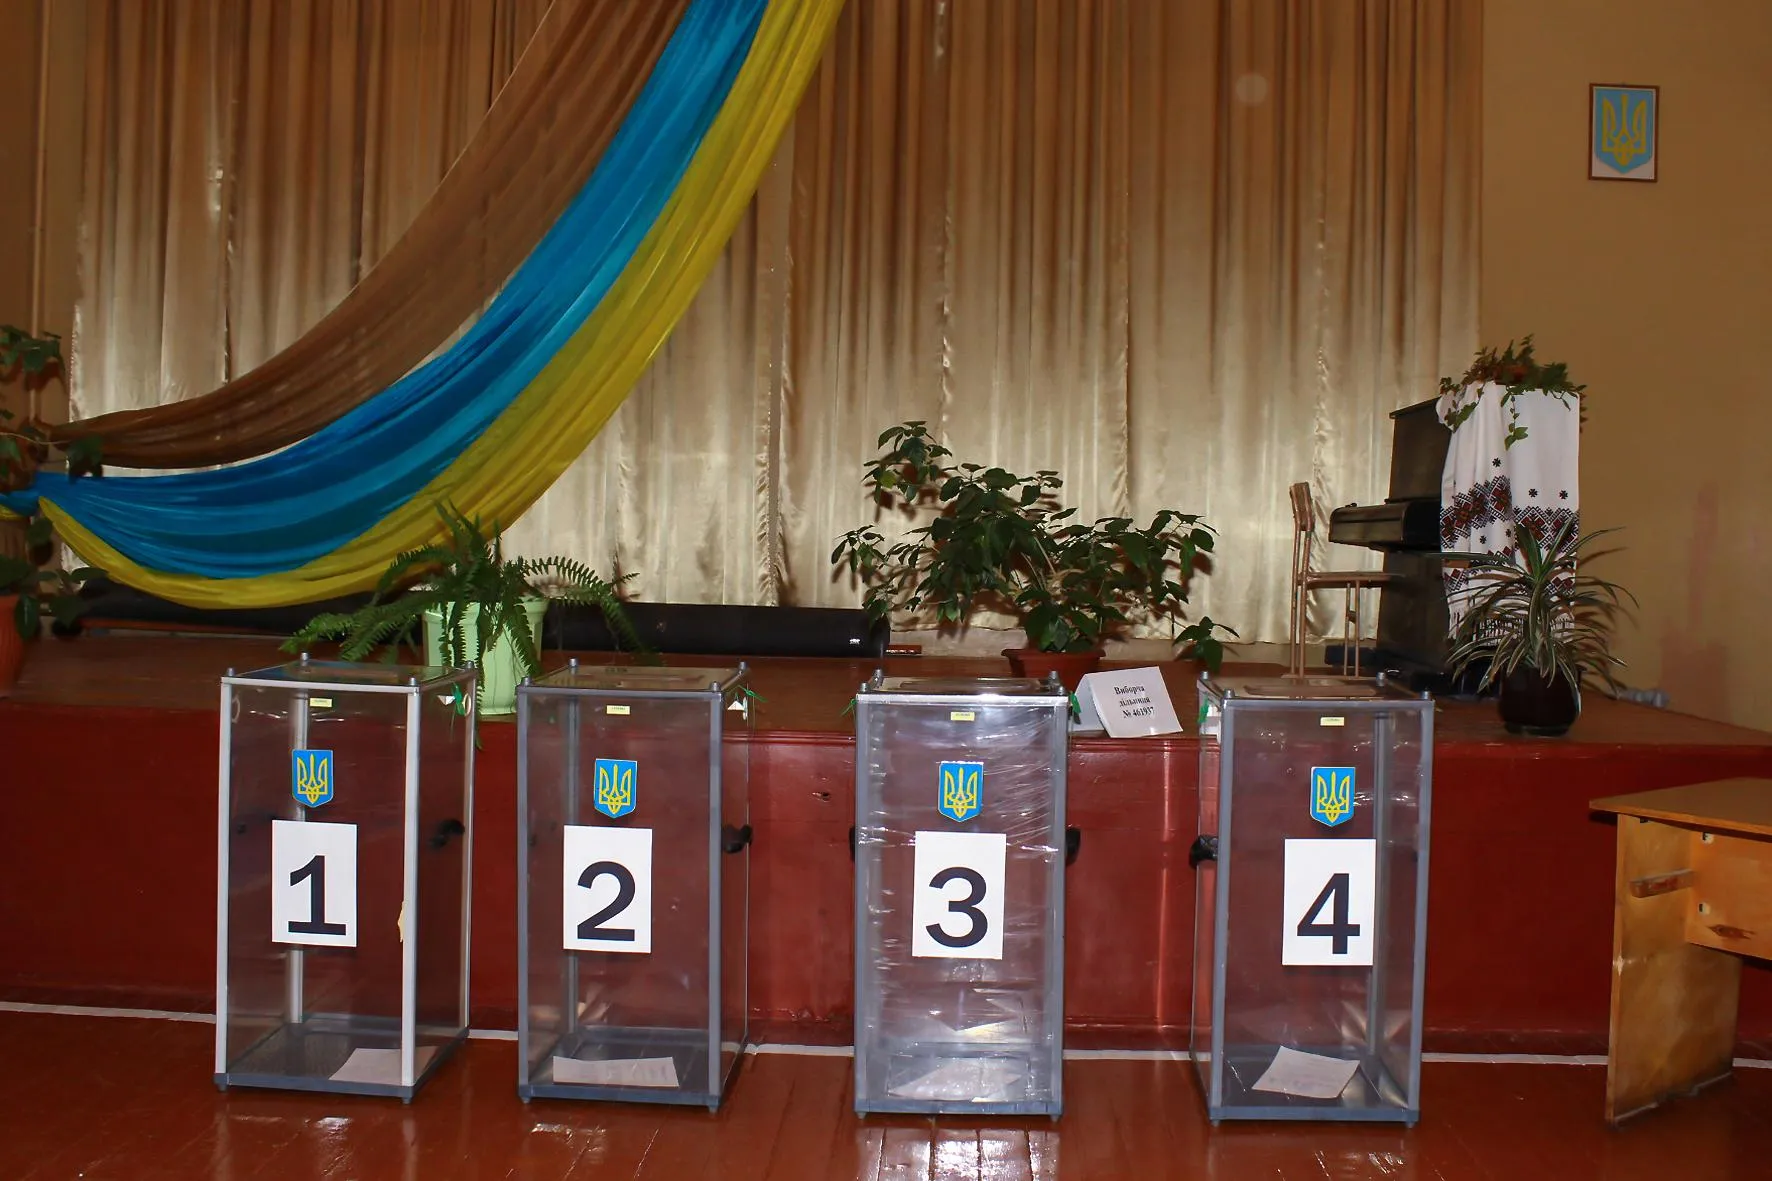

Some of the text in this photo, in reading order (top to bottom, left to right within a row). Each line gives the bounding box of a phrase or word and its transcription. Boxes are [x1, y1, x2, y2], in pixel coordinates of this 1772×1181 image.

[1114, 685, 1145, 695] Виборча
[288, 856, 346, 935] 1
[577, 861, 636, 942] 2
[925, 867, 988, 948] 3
[1296, 873, 1361, 955] 4
